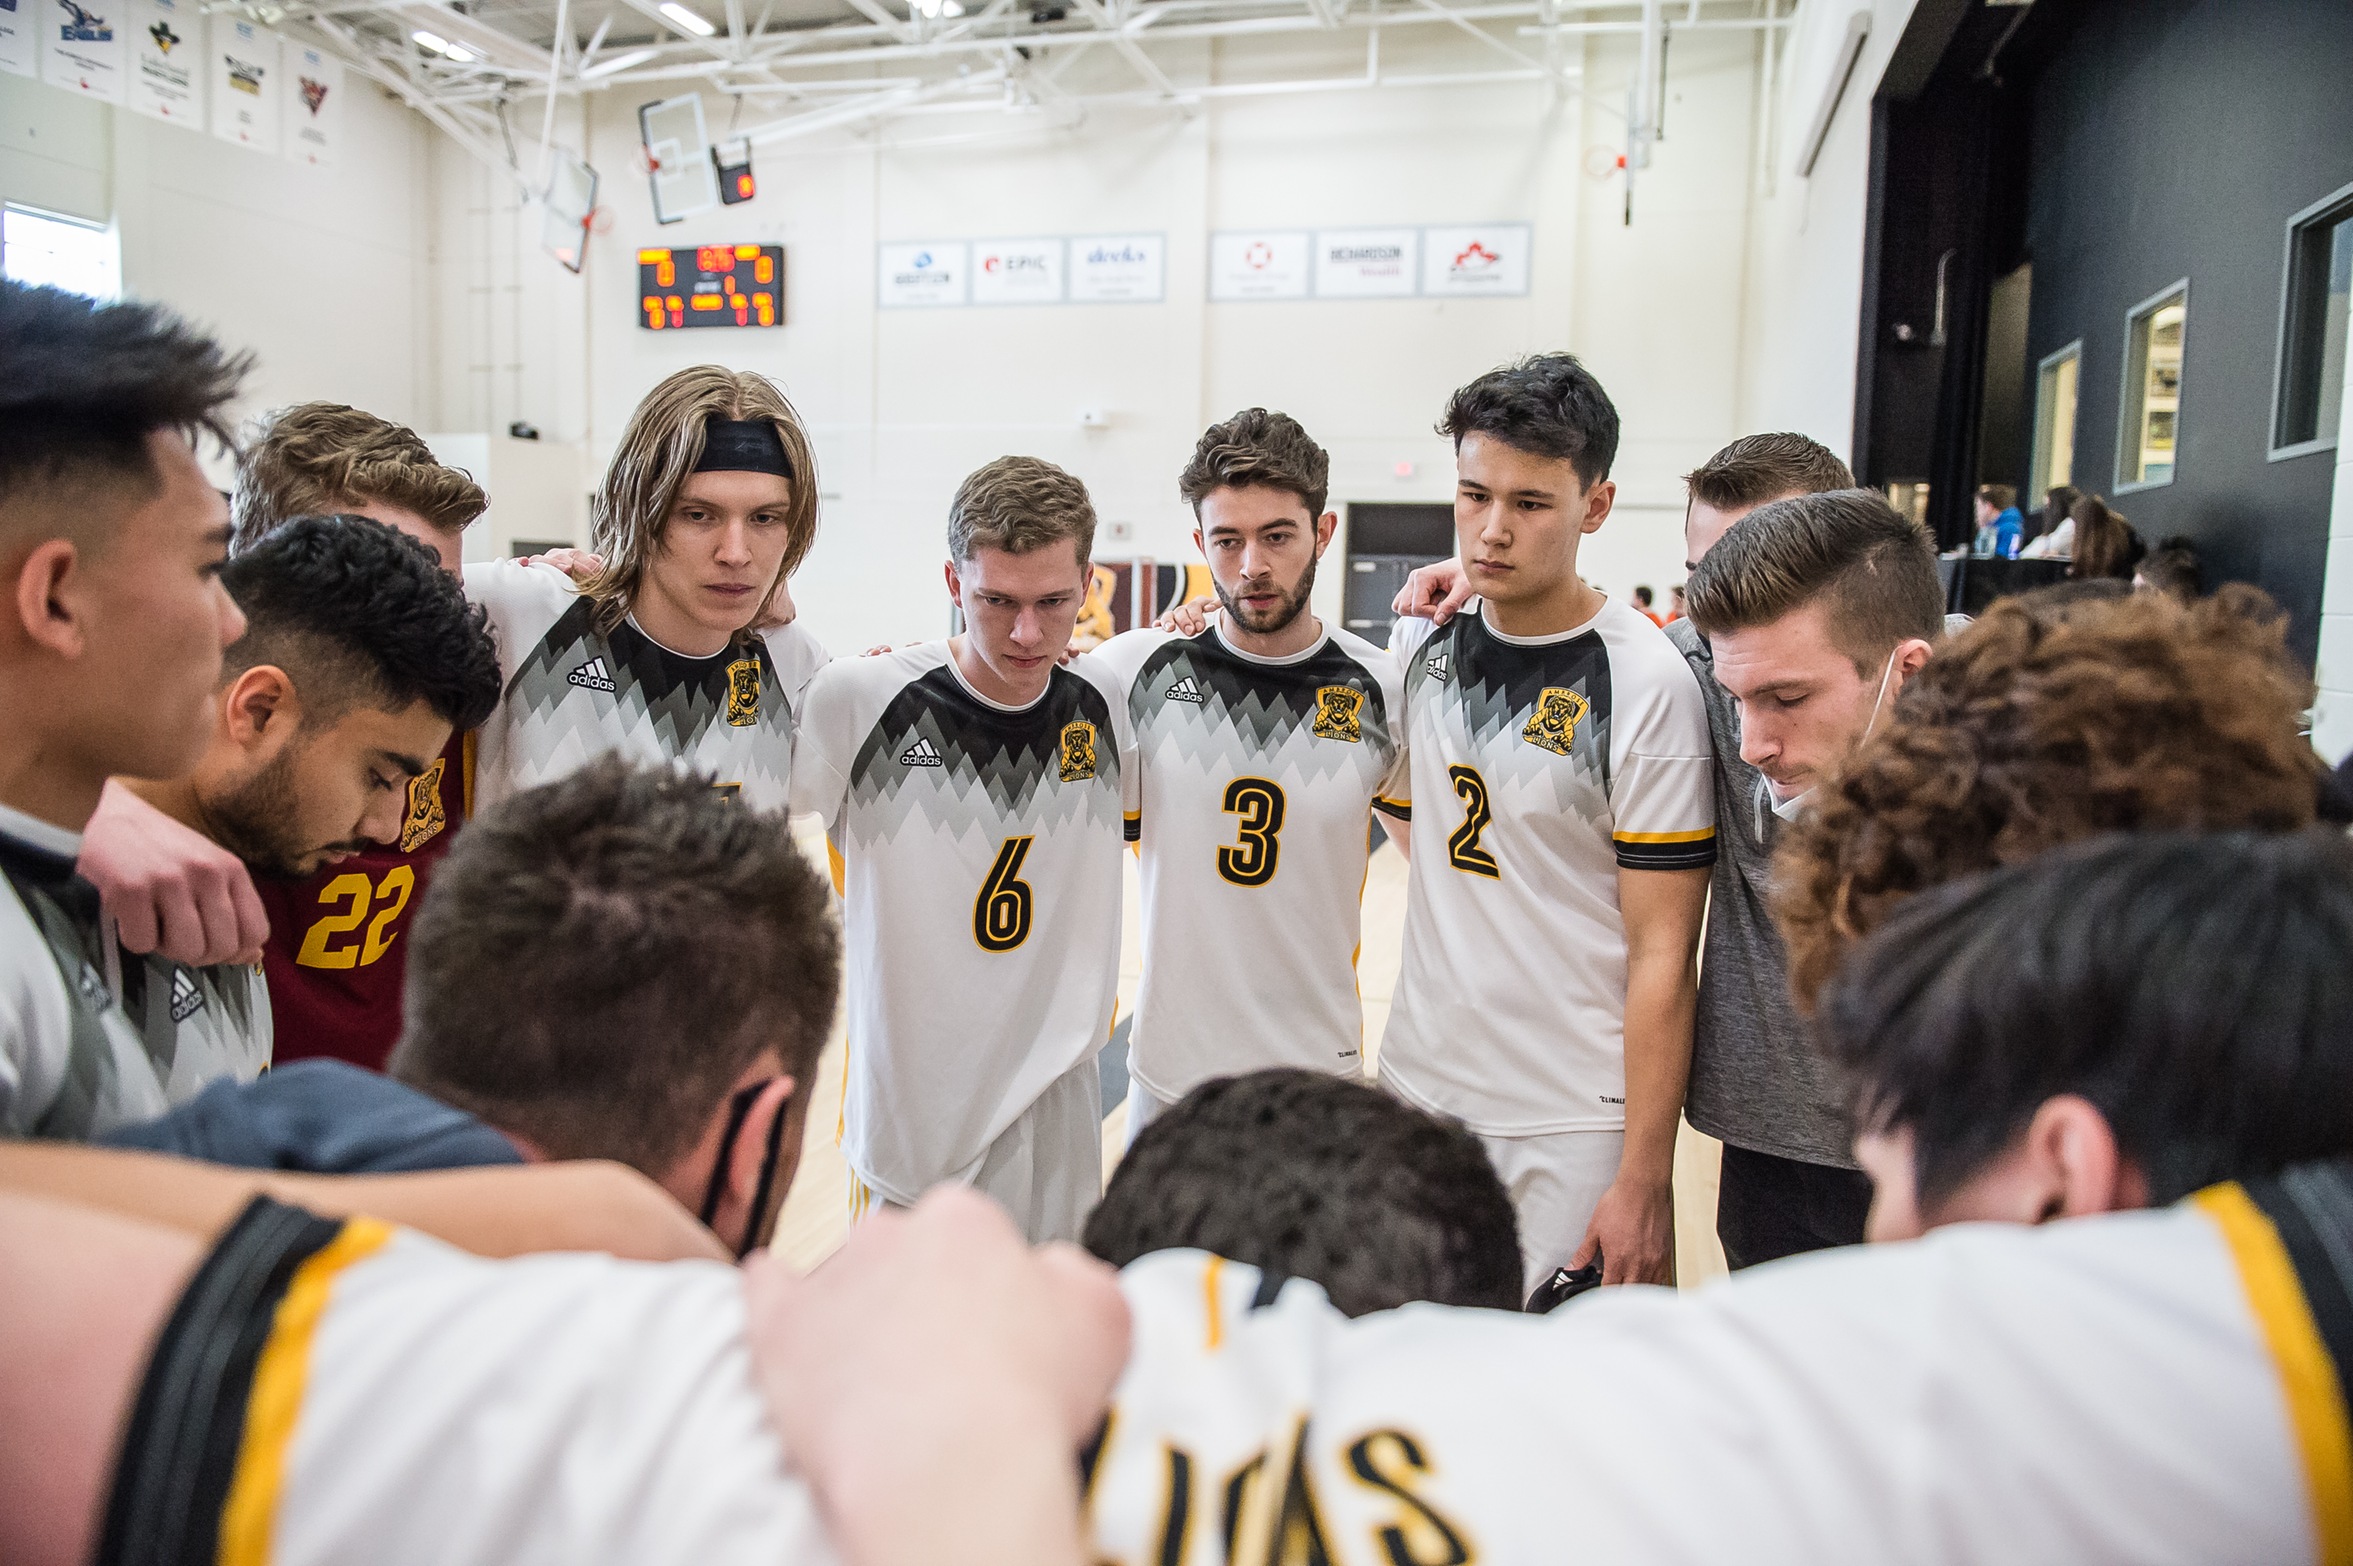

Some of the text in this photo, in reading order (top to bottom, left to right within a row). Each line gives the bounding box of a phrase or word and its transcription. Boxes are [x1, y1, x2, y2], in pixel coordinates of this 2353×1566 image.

[568, 674, 616, 691] adidas
[1166, 690, 1203, 702] adidas
[1547, 690, 1585, 707] AMBROSE
[1325, 731, 1351, 741] LIONS
[1532, 736, 1558, 751] LIONS
[901, 755, 941, 766] adidas
[1448, 763, 1501, 881] 2
[413, 824, 438, 847] LIONS
[1216, 775, 1288, 890] 3
[972, 834, 1036, 954] 6
[296, 865, 415, 969] 22
